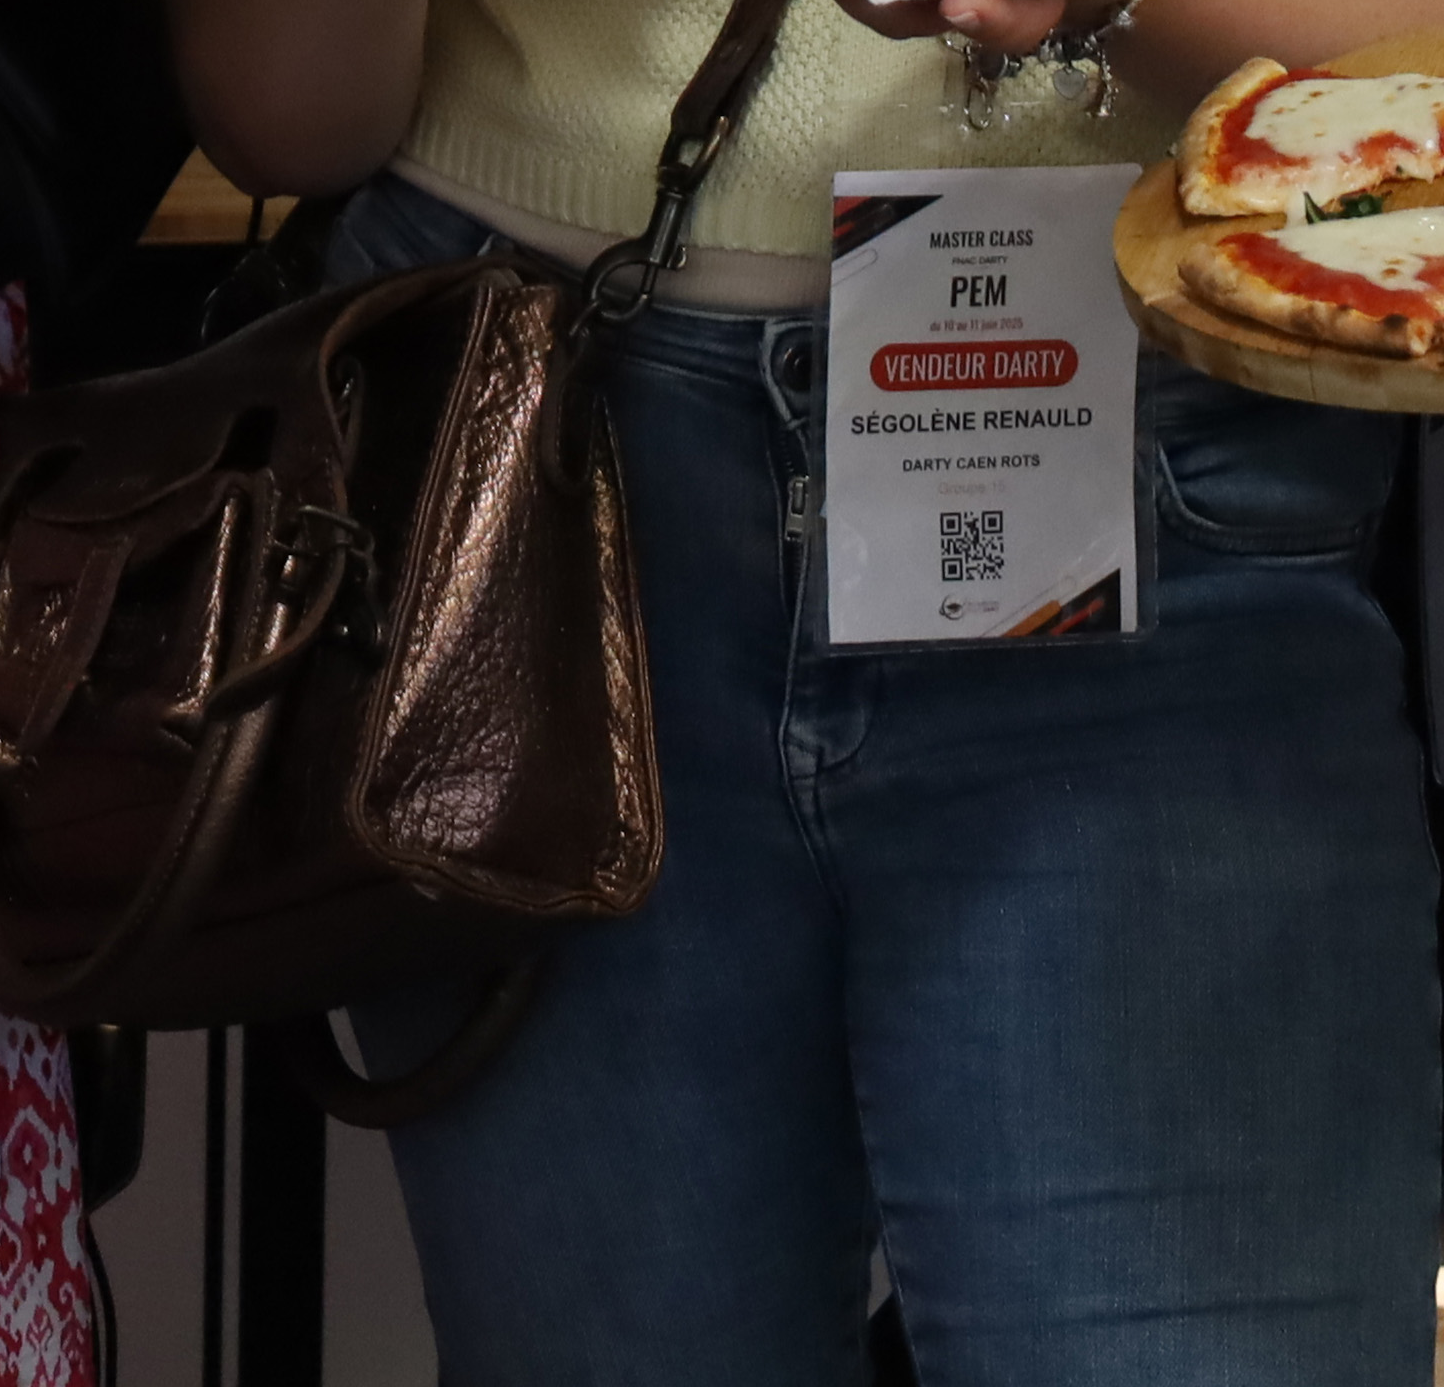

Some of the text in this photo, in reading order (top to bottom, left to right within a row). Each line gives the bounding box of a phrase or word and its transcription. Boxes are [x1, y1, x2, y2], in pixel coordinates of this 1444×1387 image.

[930, 229, 1033, 249] MASTER CLASS
[950, 274, 1007, 308] PEM
[884, 349, 1065, 383] VENDEUR DARTY
[851, 407, 1093, 435] SÉGOLÈNE RENAULD
[902, 454, 1040, 472] DARTY CAEN ROTS
